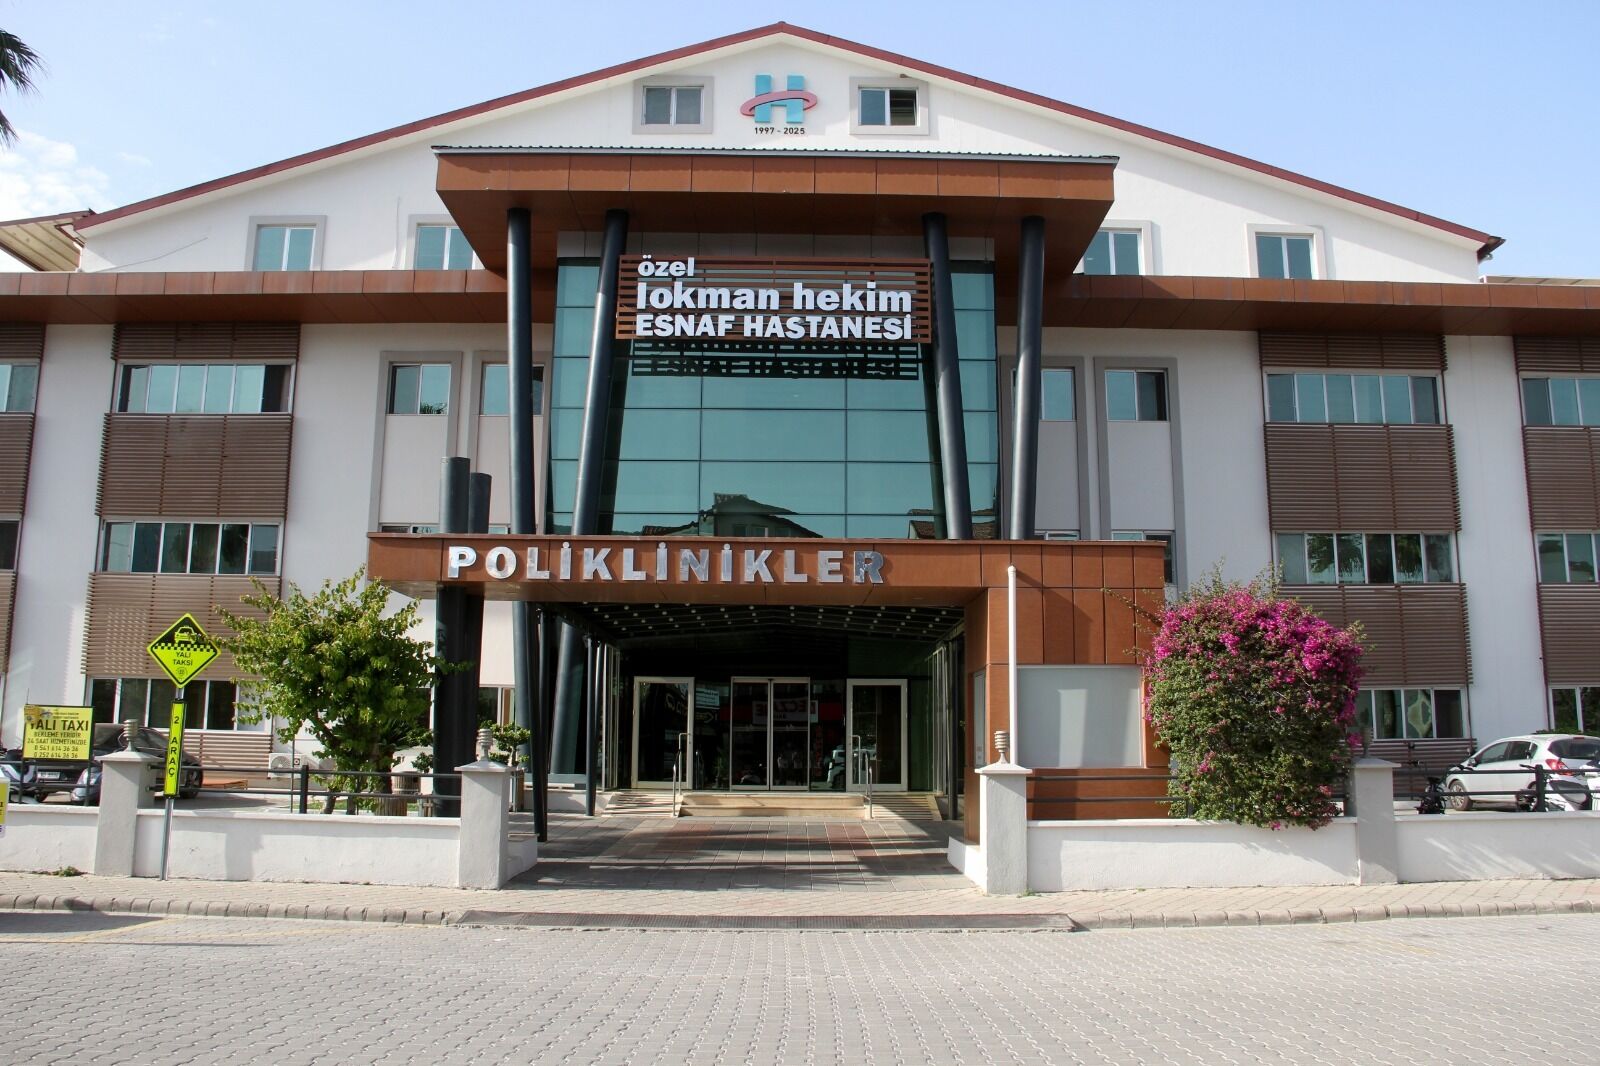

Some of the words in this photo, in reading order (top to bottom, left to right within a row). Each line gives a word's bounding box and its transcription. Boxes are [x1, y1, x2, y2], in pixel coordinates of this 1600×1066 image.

[754, 127, 775, 135] 1997
[783, 127, 805, 135] 2025
[637, 254, 695, 277] özel
[636, 281, 780, 310] lokman
[793, 281, 912, 313] hekim
[635, 314, 736, 338] ESNAF
[743, 313, 913, 340] HASTANESİ
[447, 541, 885, 585] POLİKLİNİKLER
[173, 658, 193, 666] TAKSİ
[61, 720, 88, 731] TAXI
[173, 716, 180, 724] 2
[168, 736, 178, 777] ARAÇ
